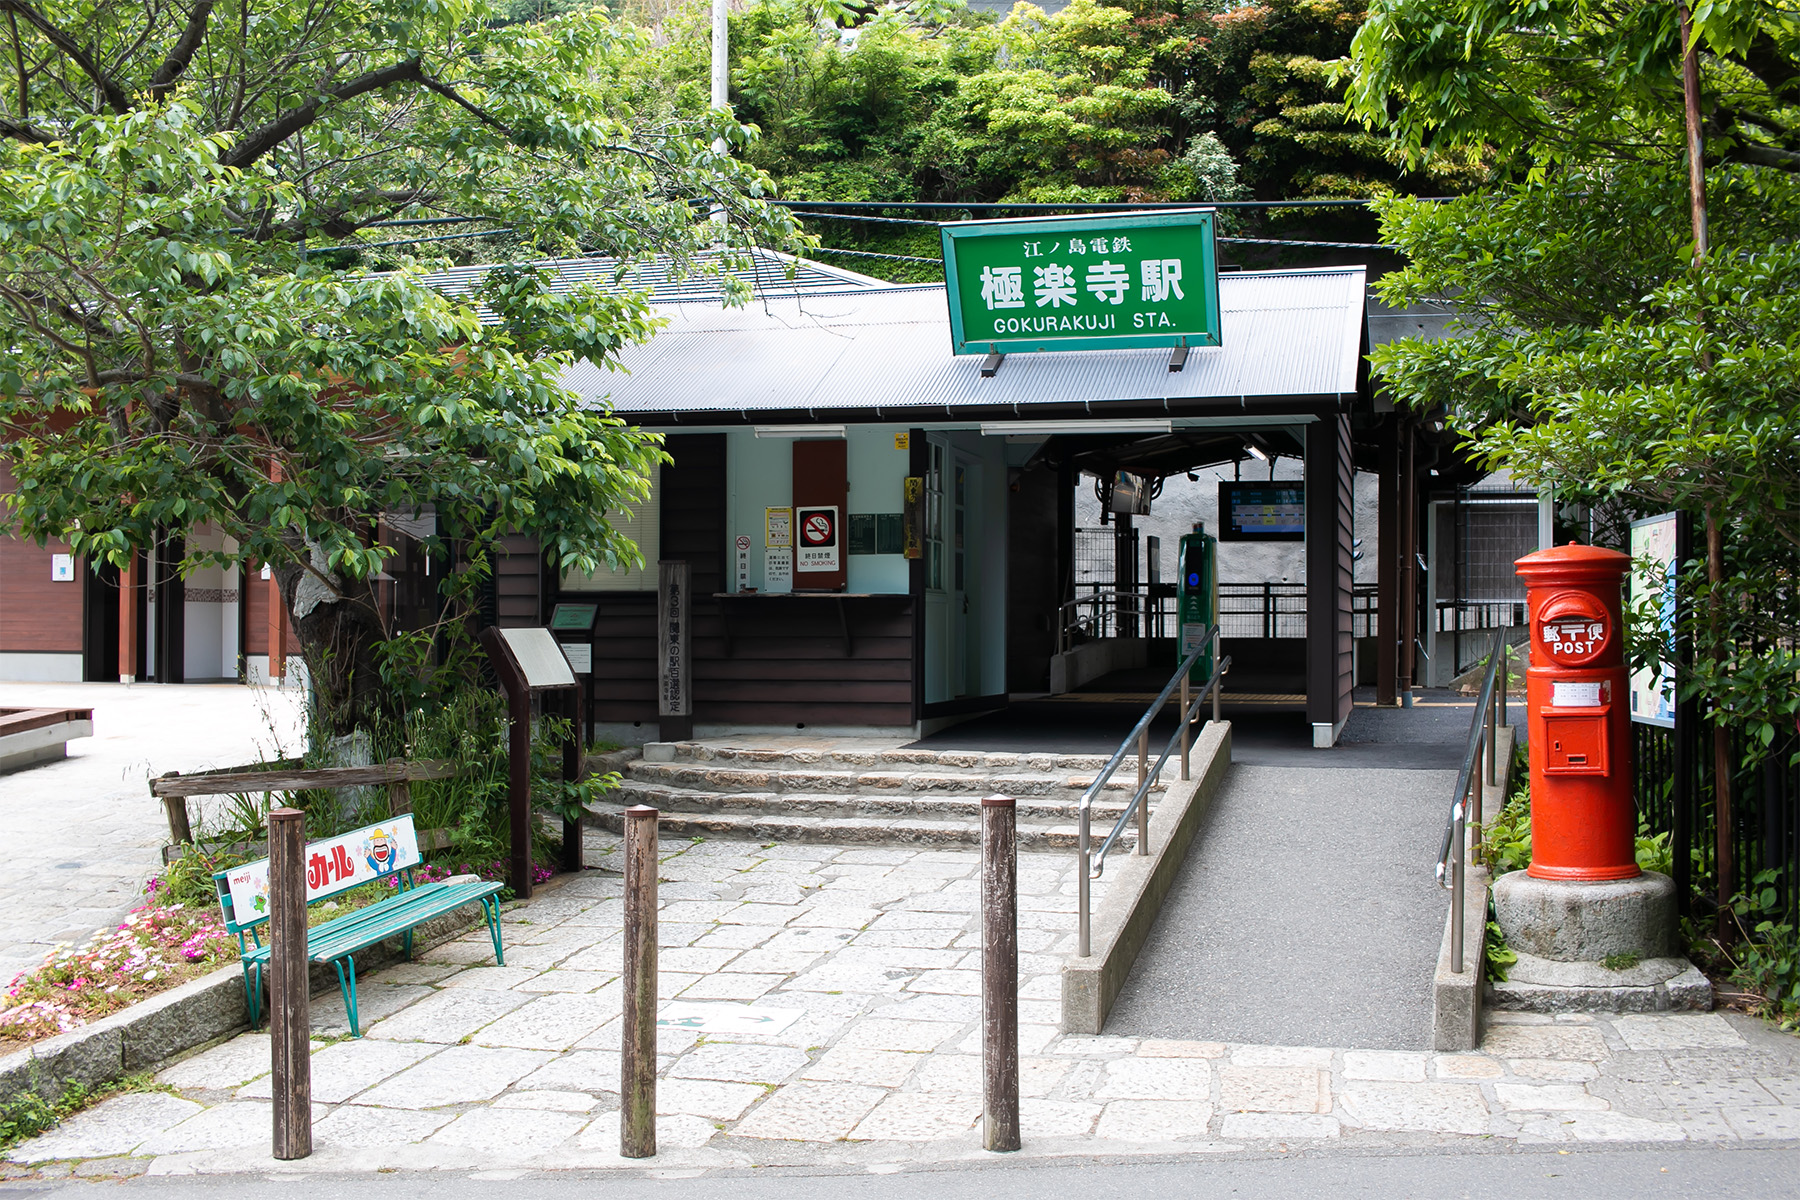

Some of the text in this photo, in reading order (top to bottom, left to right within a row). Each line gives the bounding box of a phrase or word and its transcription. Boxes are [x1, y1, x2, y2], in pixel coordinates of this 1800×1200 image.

[1023, 236, 1133, 258] 江ノ島電鉄
[980, 258, 1185, 311] 極楽寺駅
[994, 312, 1177, 334] GOKURAKUJI STA.
[1554, 642, 1594, 654] POST
[233, 871, 252, 885] meiji
[308, 845, 354, 889] カール
